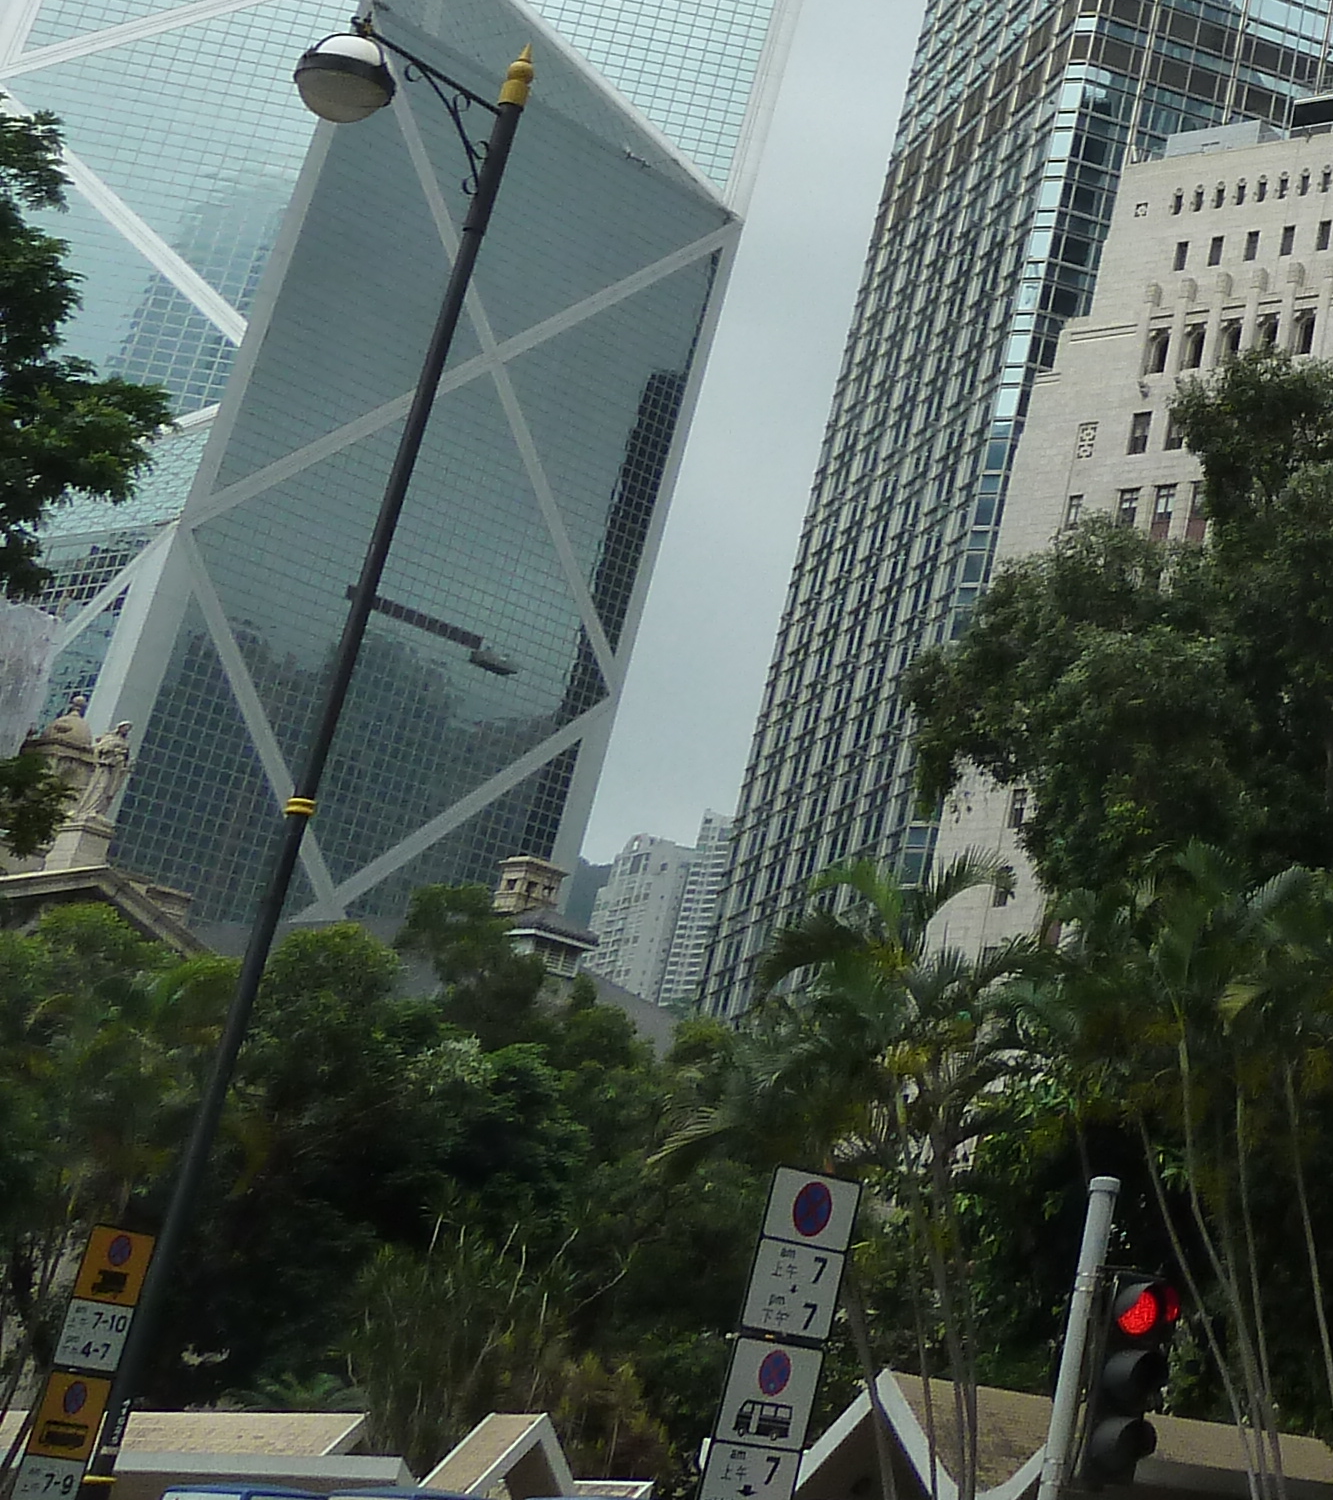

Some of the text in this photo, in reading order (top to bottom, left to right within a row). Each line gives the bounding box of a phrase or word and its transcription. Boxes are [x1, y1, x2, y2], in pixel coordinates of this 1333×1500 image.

[780, 1248, 797, 1259] am
[771, 1256, 828, 1284] 上午 7
[91, 1311, 128, 1333] 7-10
[762, 1303, 818, 1331] 下午 7
[81, 1341, 112, 1360] 4-7
[730, 1449, 747, 1460] am
[720, 1456, 781, 1485] 上午 7
[41, 1473, 75, 1495] 7-9
